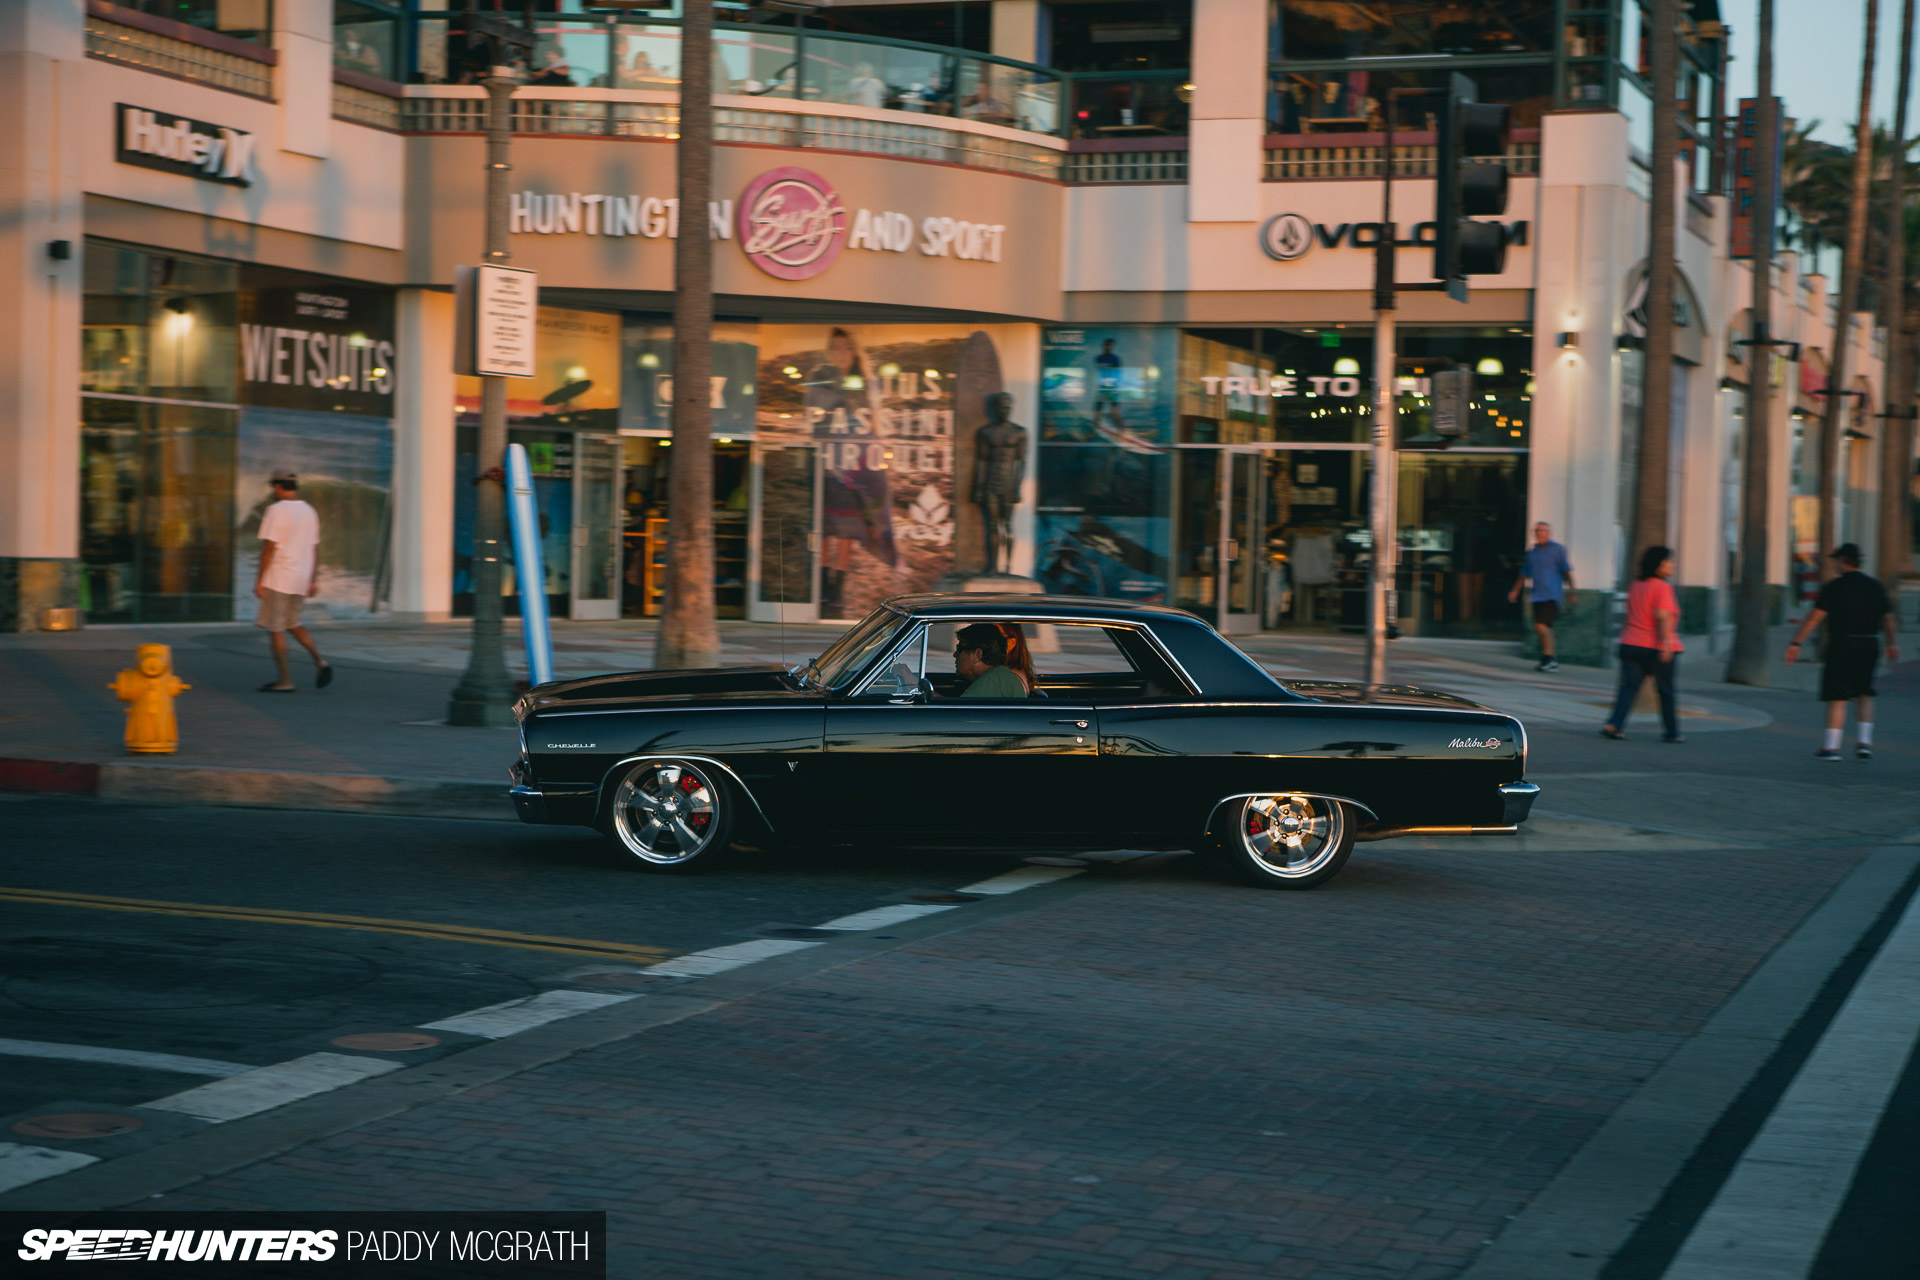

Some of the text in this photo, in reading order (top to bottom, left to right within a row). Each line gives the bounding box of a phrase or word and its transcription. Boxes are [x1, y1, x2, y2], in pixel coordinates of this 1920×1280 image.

[124, 108, 226, 173] Hurley
[509, 190, 733, 239] HUNTINGTN
[848, 208, 914, 252] AND
[919, 216, 1005, 263] SPORT
[239, 323, 395, 394] WETSUITS
[1200, 376, 1298, 396] TRUE
[1307, 376, 1361, 398] TO
[1447, 737, 1487, 749] Malibu
